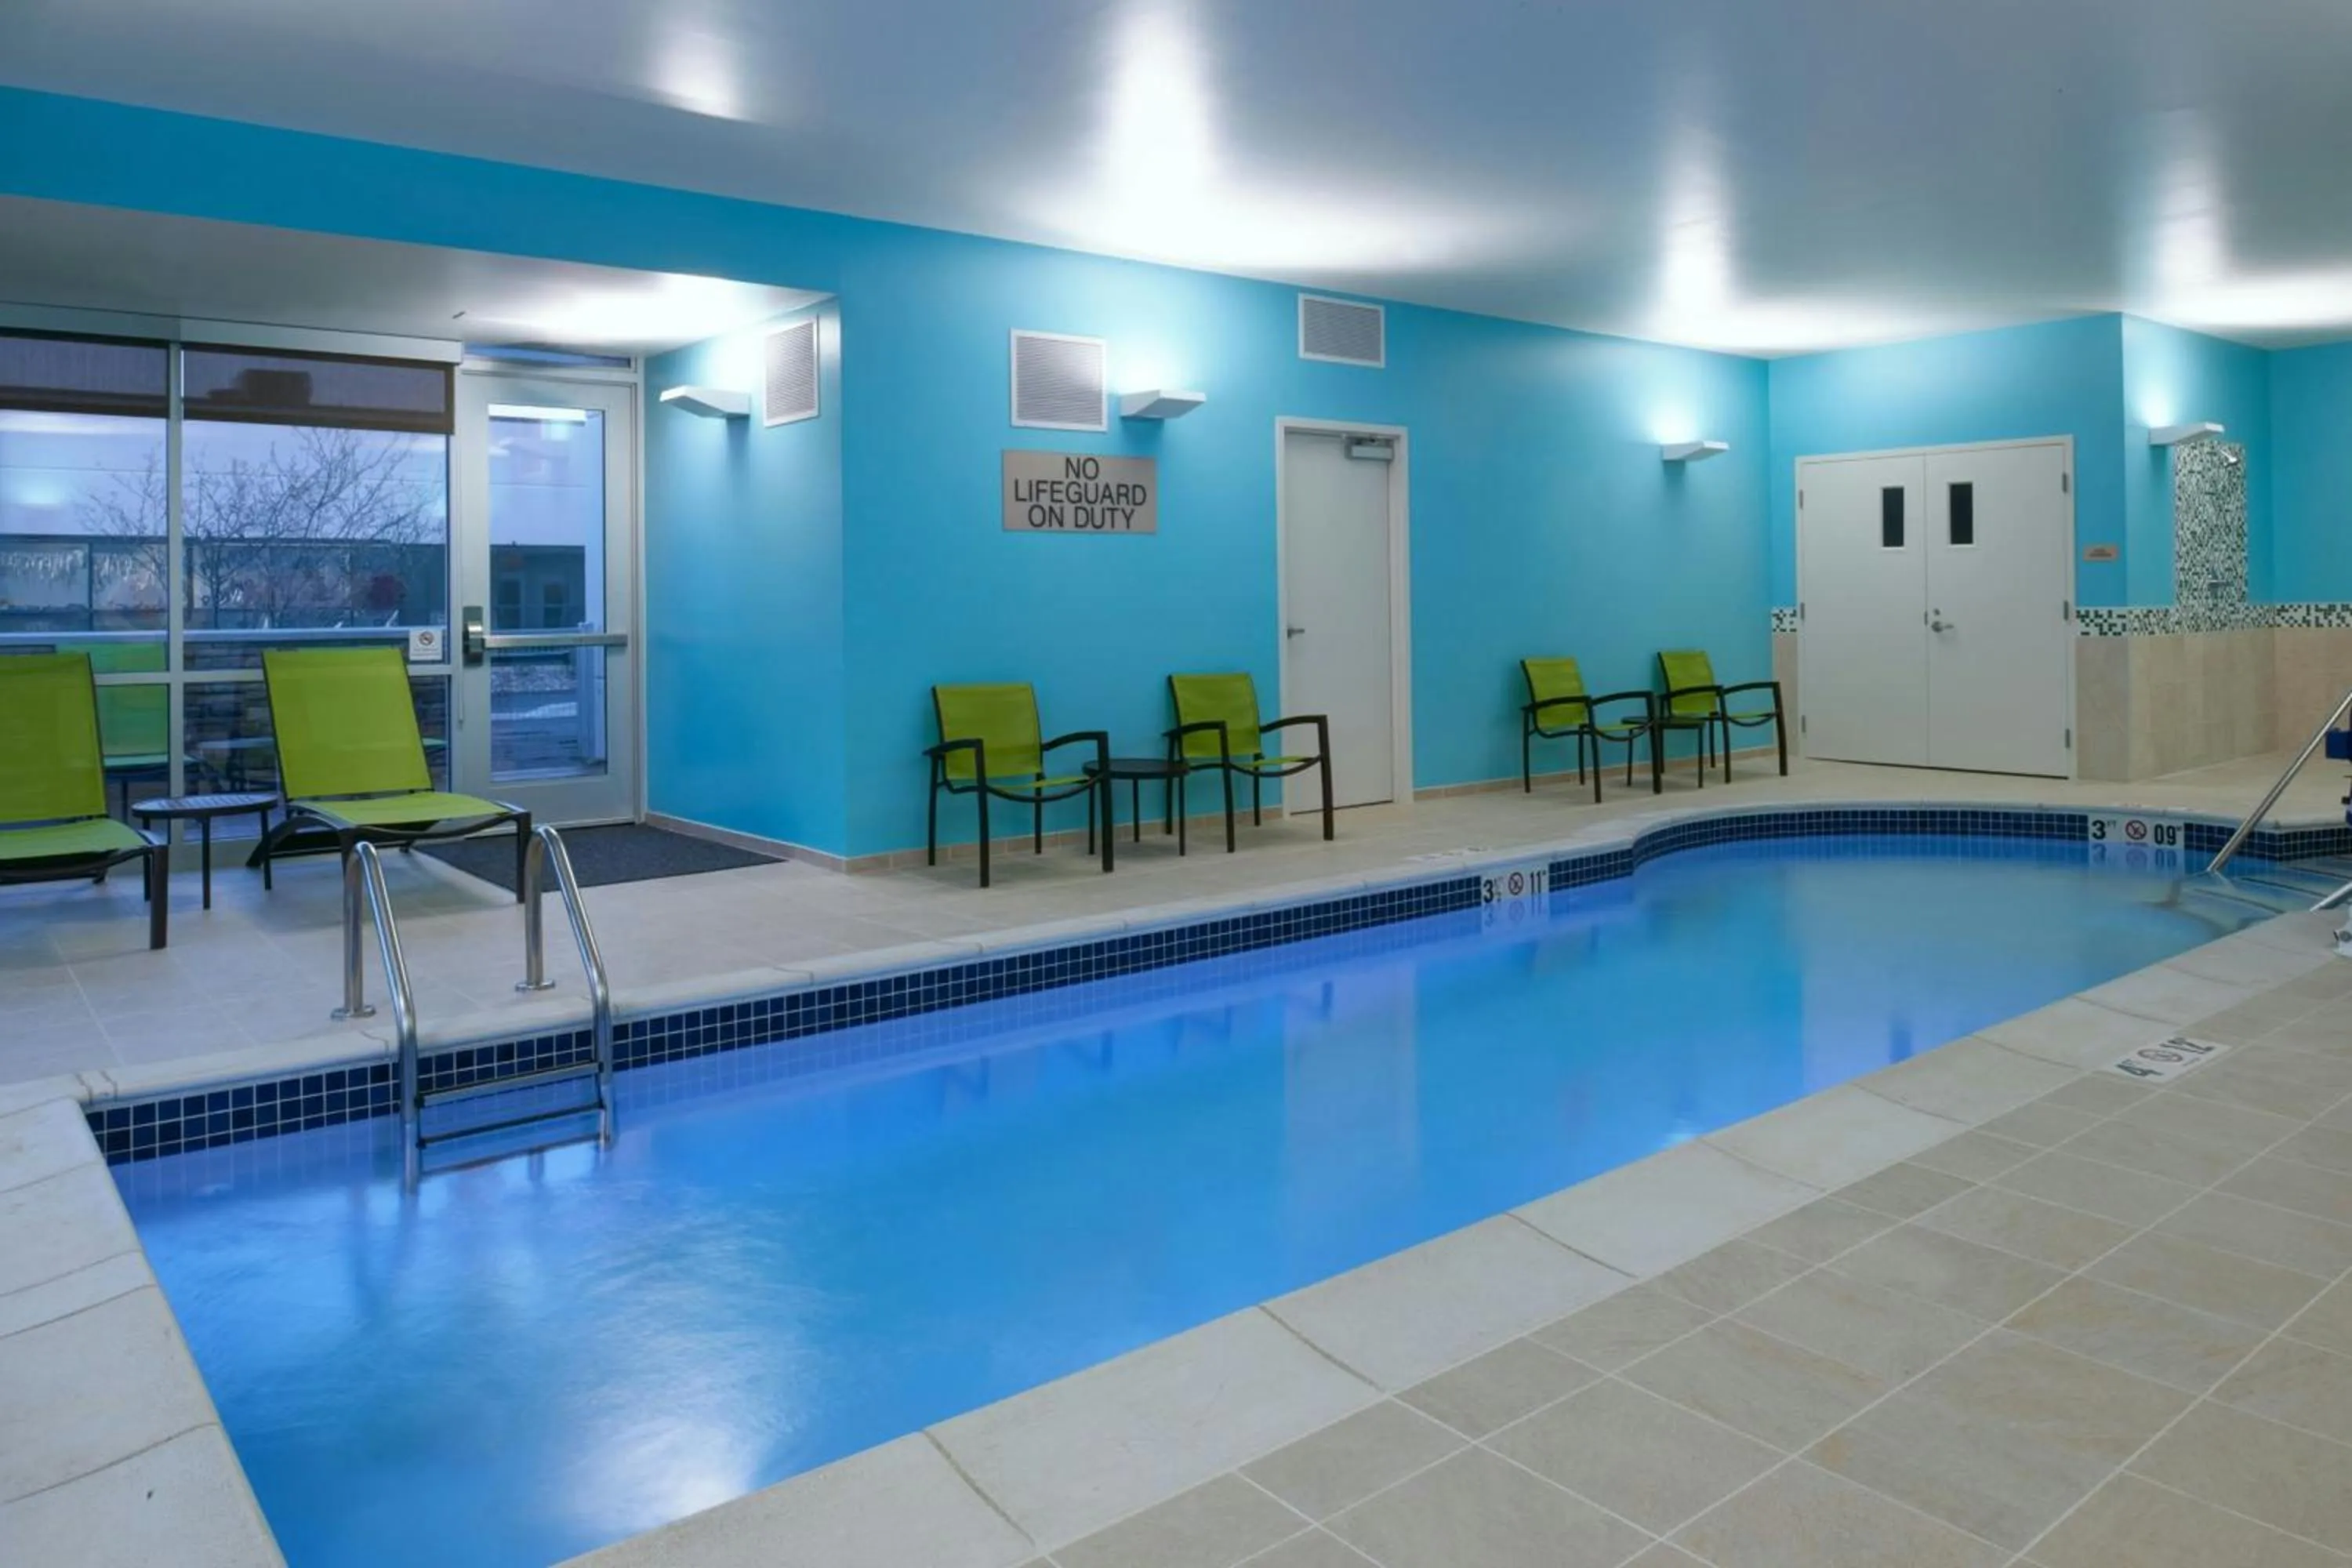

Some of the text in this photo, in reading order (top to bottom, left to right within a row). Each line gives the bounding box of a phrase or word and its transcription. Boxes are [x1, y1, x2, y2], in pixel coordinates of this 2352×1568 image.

[1065, 457, 1099, 480] NO
[1014, 478, 1147, 506] LIFEGUARD
[1028, 504, 1135, 529] ON DUTY
[2092, 820, 2106, 840] 3
[1483, 879, 1494, 903] 3
